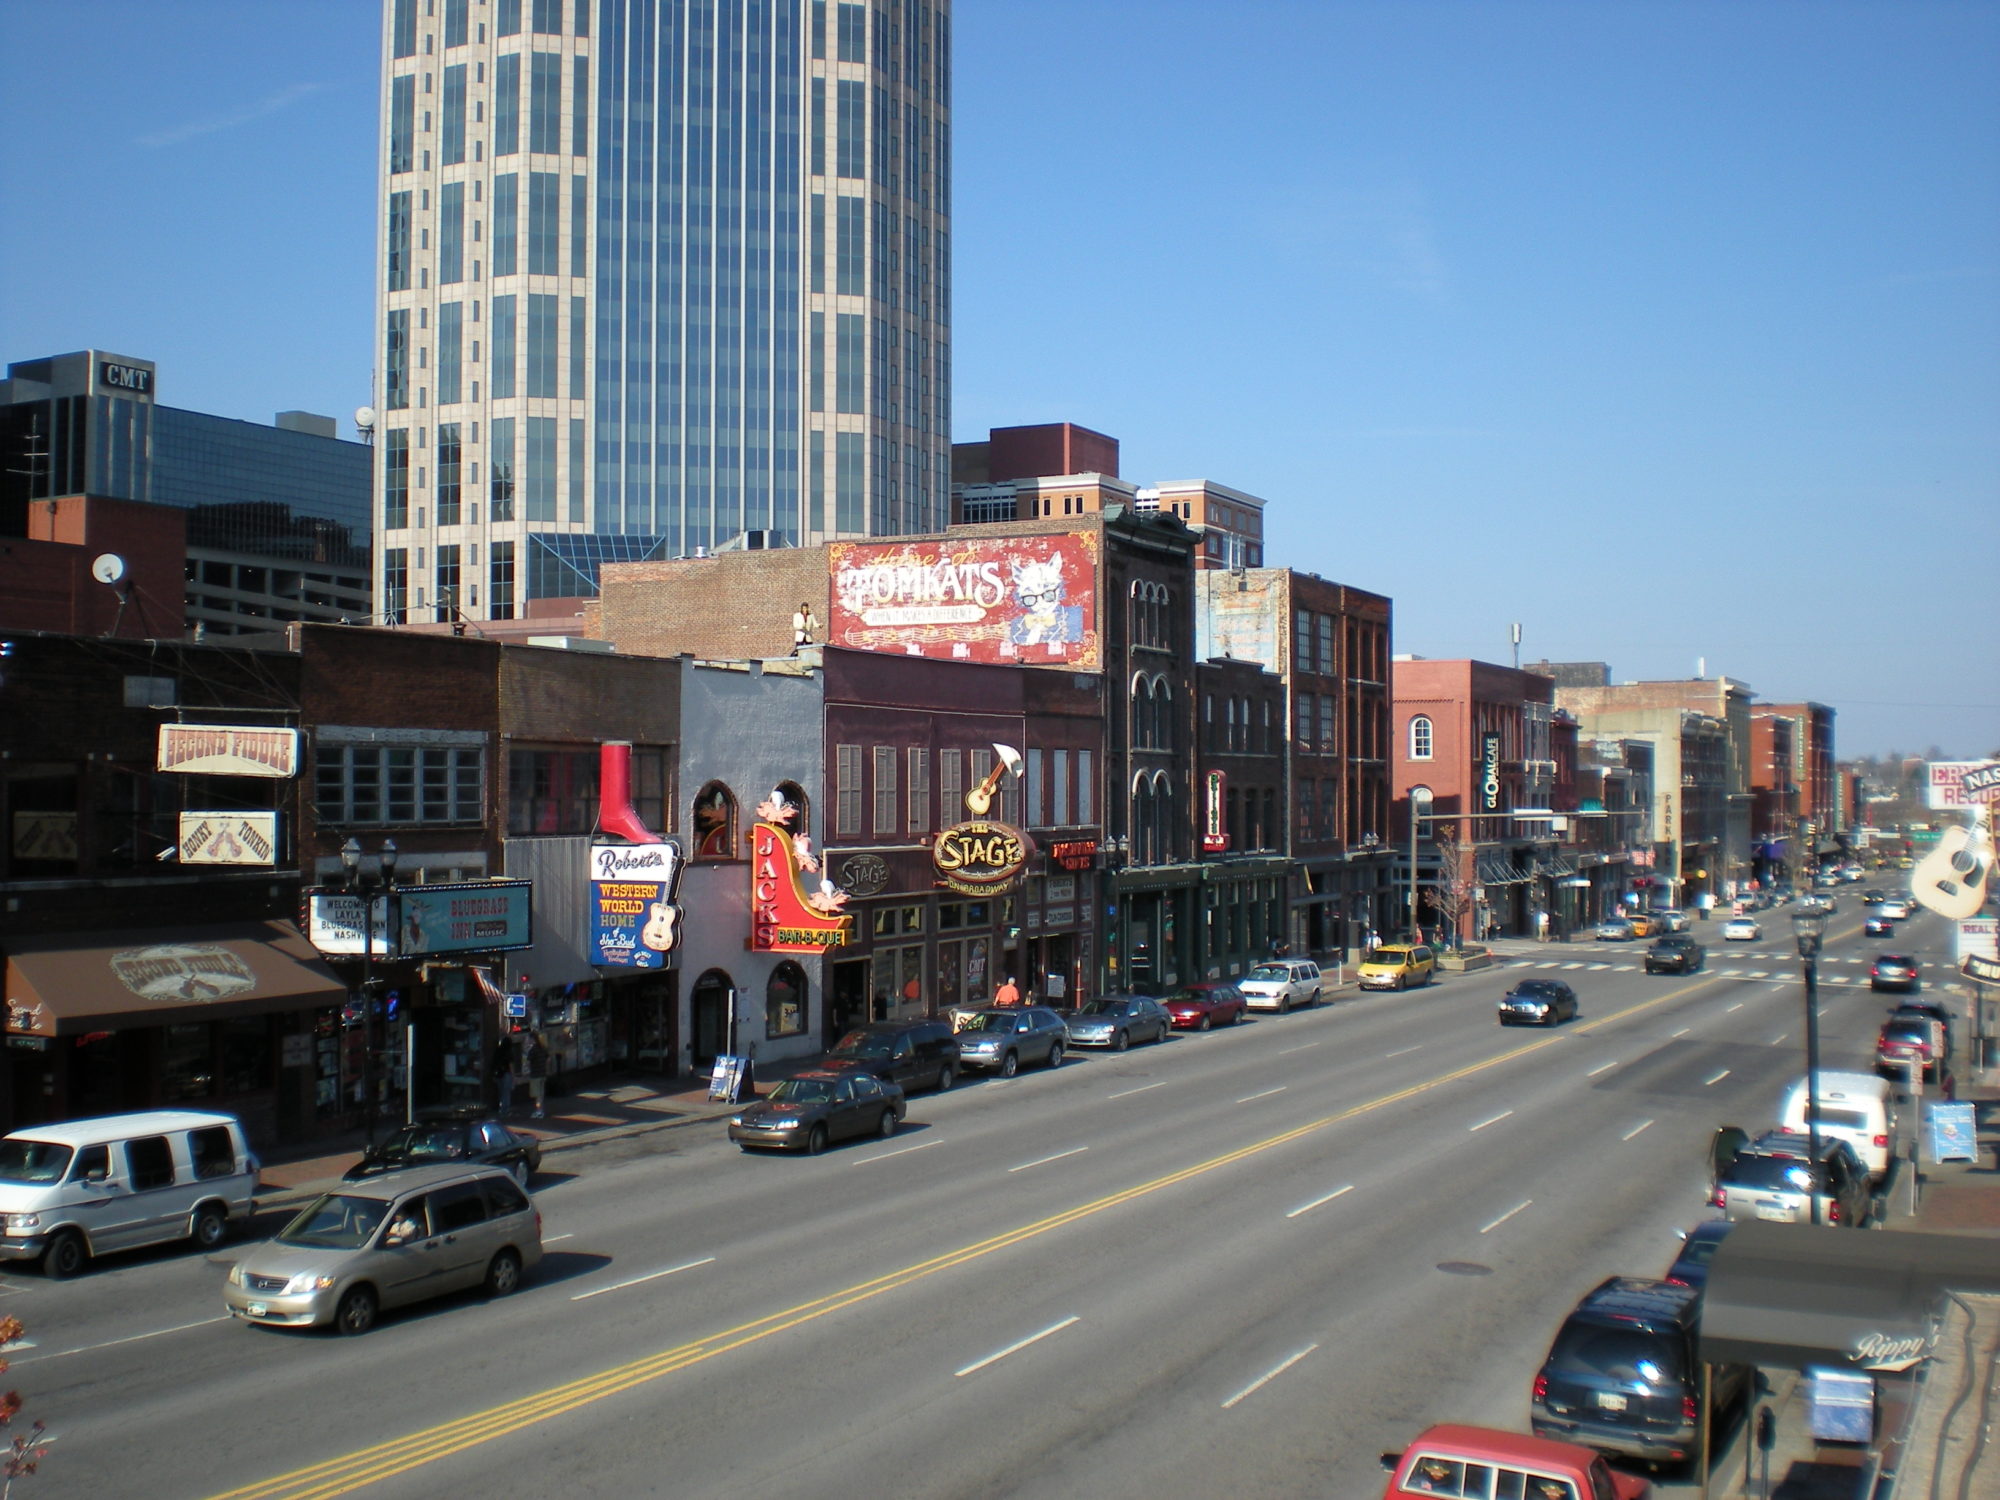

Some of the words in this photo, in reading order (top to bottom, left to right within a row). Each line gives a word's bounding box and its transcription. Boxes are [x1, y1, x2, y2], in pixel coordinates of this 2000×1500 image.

[107, 364, 147, 390] CMT
[844, 558, 1005, 613] TOMKATS
[166, 730, 227, 767] SECOND
[232, 731, 289, 773] FIDDLE
[971, 824, 988, 833] THE
[182, 820, 212, 859] HONKY
[940, 830, 1021, 870] STAGE
[598, 850, 664, 878] Robert's
[842, 861, 888, 888] STAGE
[600, 884, 658, 898] WESTERN
[757, 837, 780, 947] JACKS
[949, 880, 960, 889] ON
[963, 881, 1009, 894] BROADWAY
[327, 900, 365, 909] WELCOME
[451, 898, 509, 917] BLUEGRASS
[600, 900, 644, 913] WORLD
[321, 921, 363, 930] BLUEGRAS
[601, 915, 635, 927] HOME
[1963, 925, 1991, 934] REAL
[334, 931, 377, 939] NASHVIE
[778, 929, 842, 944] BAR-B-QUE
[1848, 1324, 1941, 1364] Rippy's
